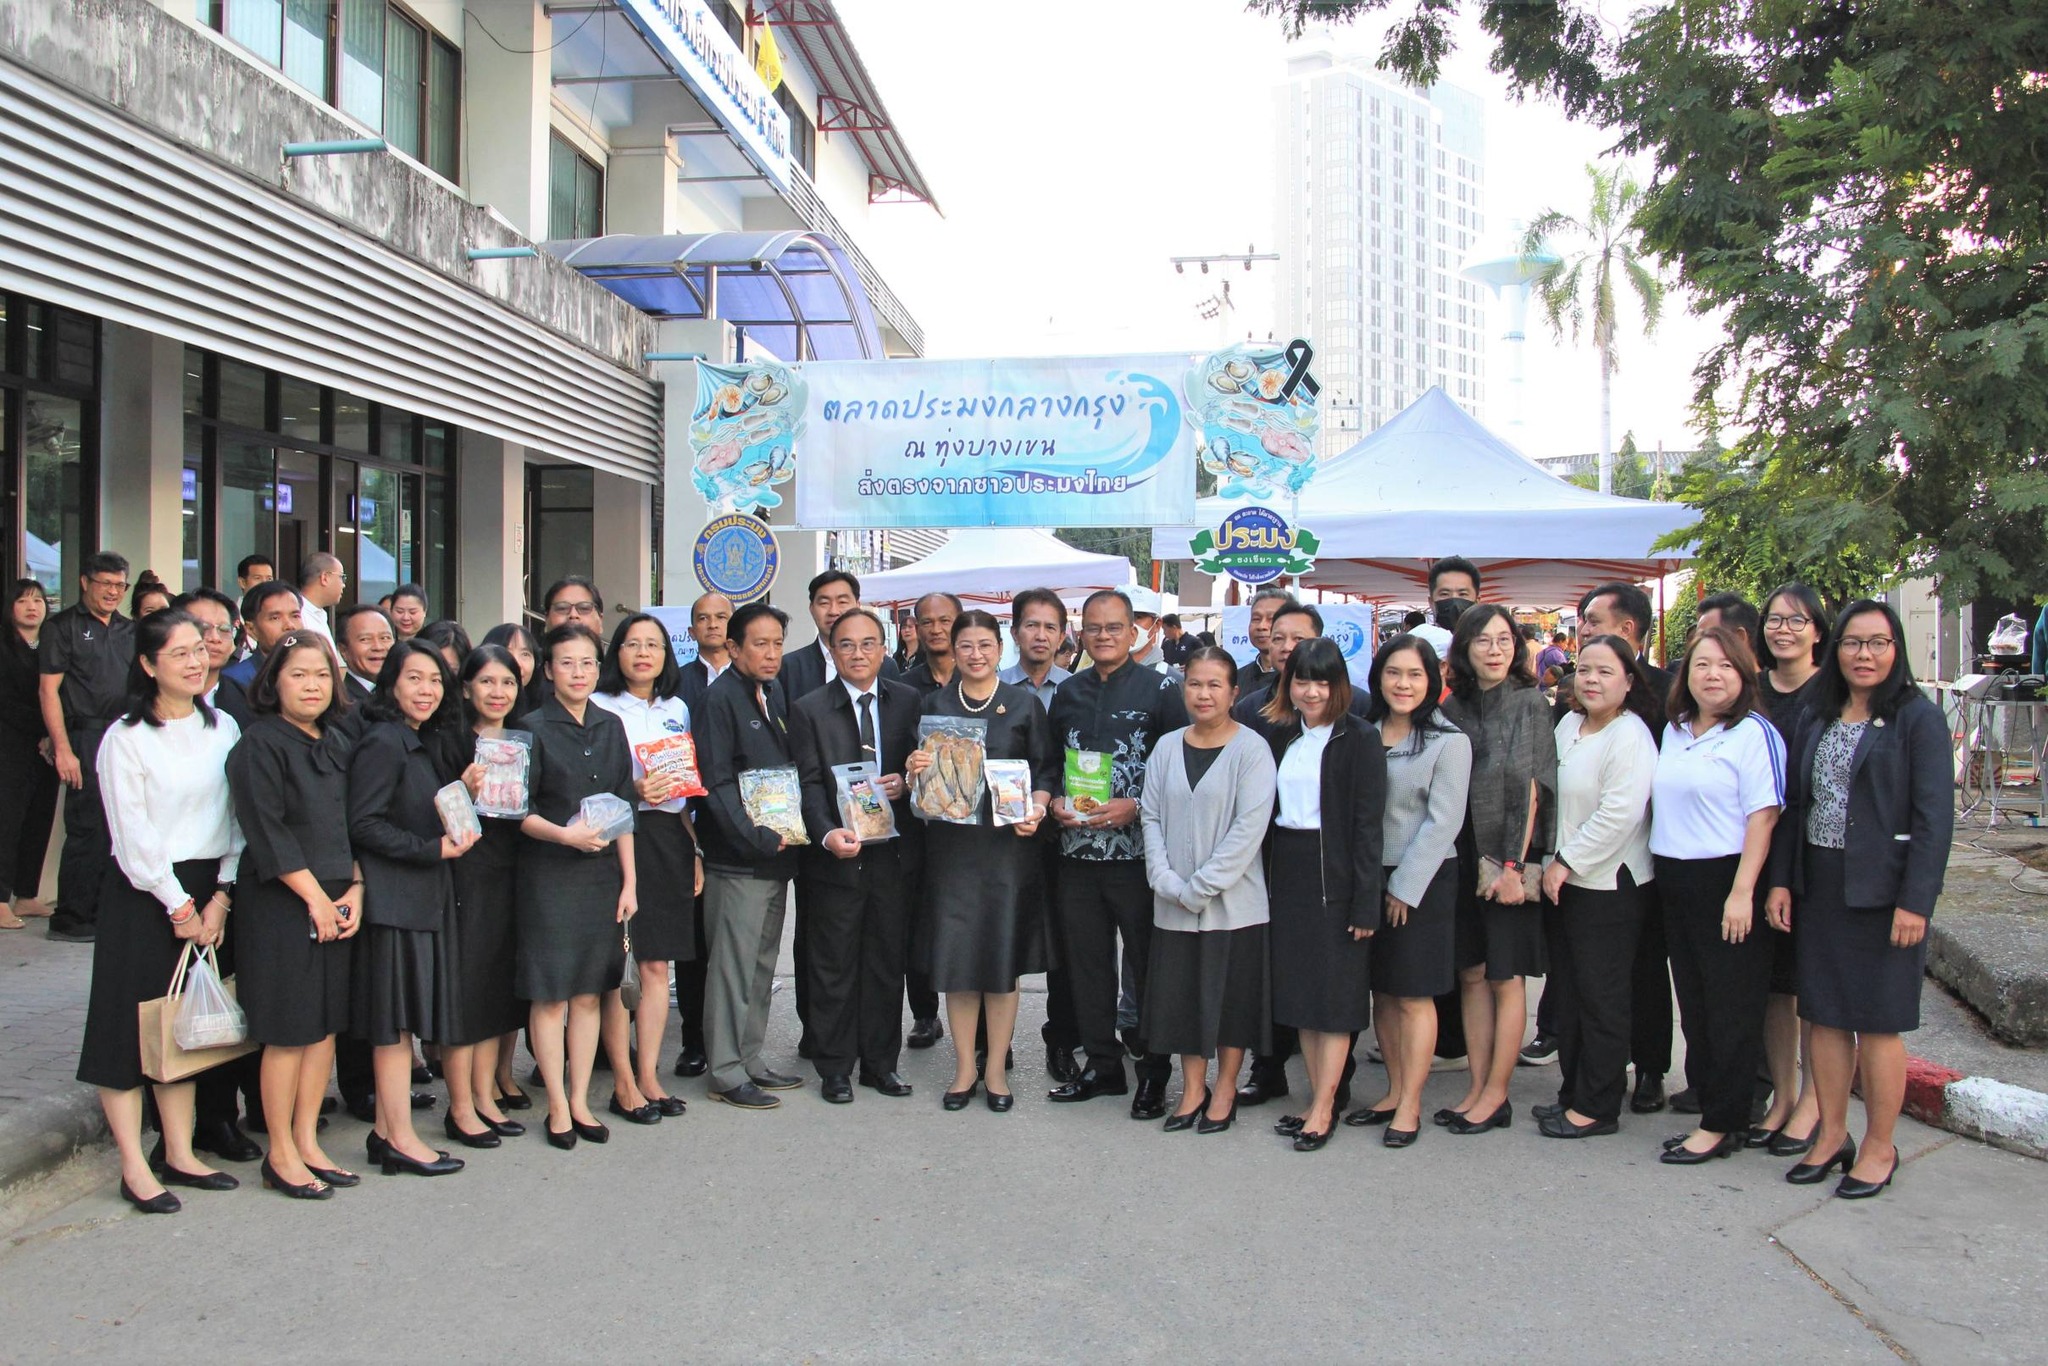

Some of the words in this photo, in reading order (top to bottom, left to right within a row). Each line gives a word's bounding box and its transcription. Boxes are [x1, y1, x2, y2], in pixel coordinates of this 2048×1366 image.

[823, 389, 1126, 430] ตลาดประมงกลางกรุง
[904, 438, 926, 458] ณ
[935, 427, 1056, 468] ทุ่งบางเขน
[857, 469, 1129, 496] ส่งตรงจากชาวประมงไทย
[703, 515, 767, 540] กรมประมง
[1213, 520, 1298, 550] ประมง
